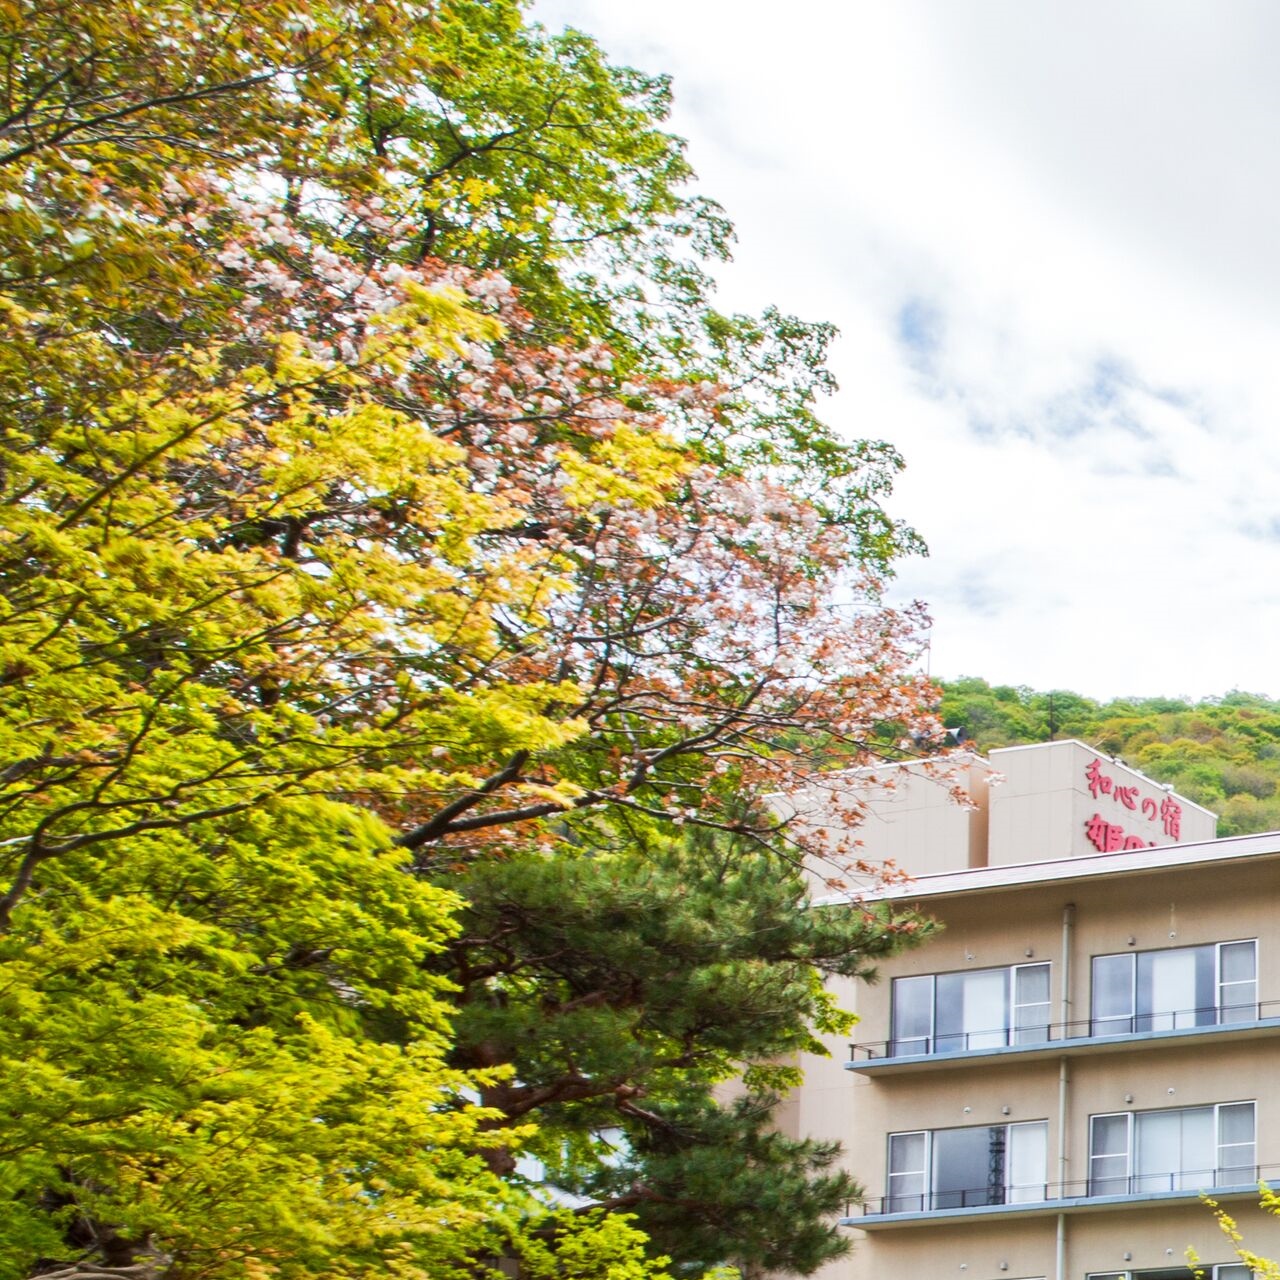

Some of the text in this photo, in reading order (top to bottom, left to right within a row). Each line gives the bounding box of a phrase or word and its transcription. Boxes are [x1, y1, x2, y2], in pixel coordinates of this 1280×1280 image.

[1085, 759, 1182, 841] 和心の宿
[1084, 813, 1157, 852] 姫の
